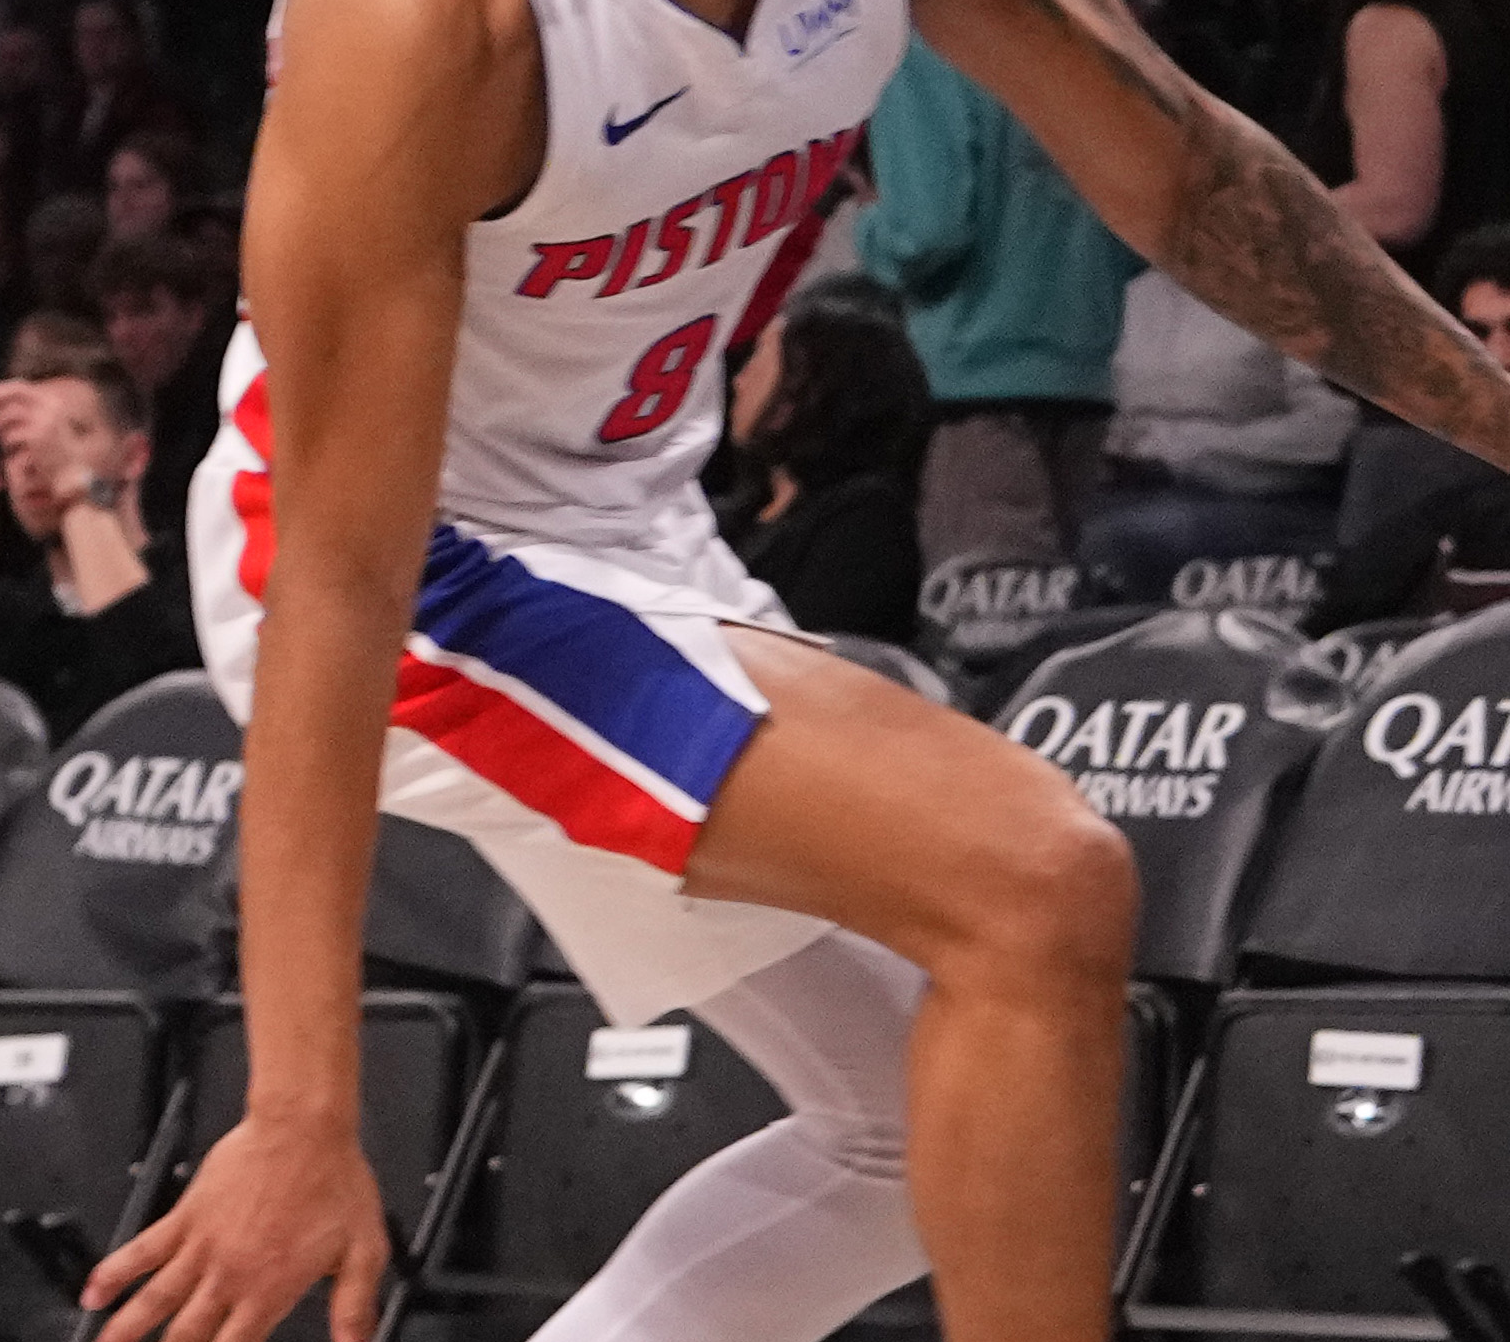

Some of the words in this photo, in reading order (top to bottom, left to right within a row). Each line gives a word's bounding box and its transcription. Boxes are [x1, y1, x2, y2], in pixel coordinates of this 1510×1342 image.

[598, 312, 719, 444] 8
[1007, 695, 1247, 770] QATAR
[49, 751, 244, 826] QATAR
[1075, 771, 1219, 818] IRWAYS
